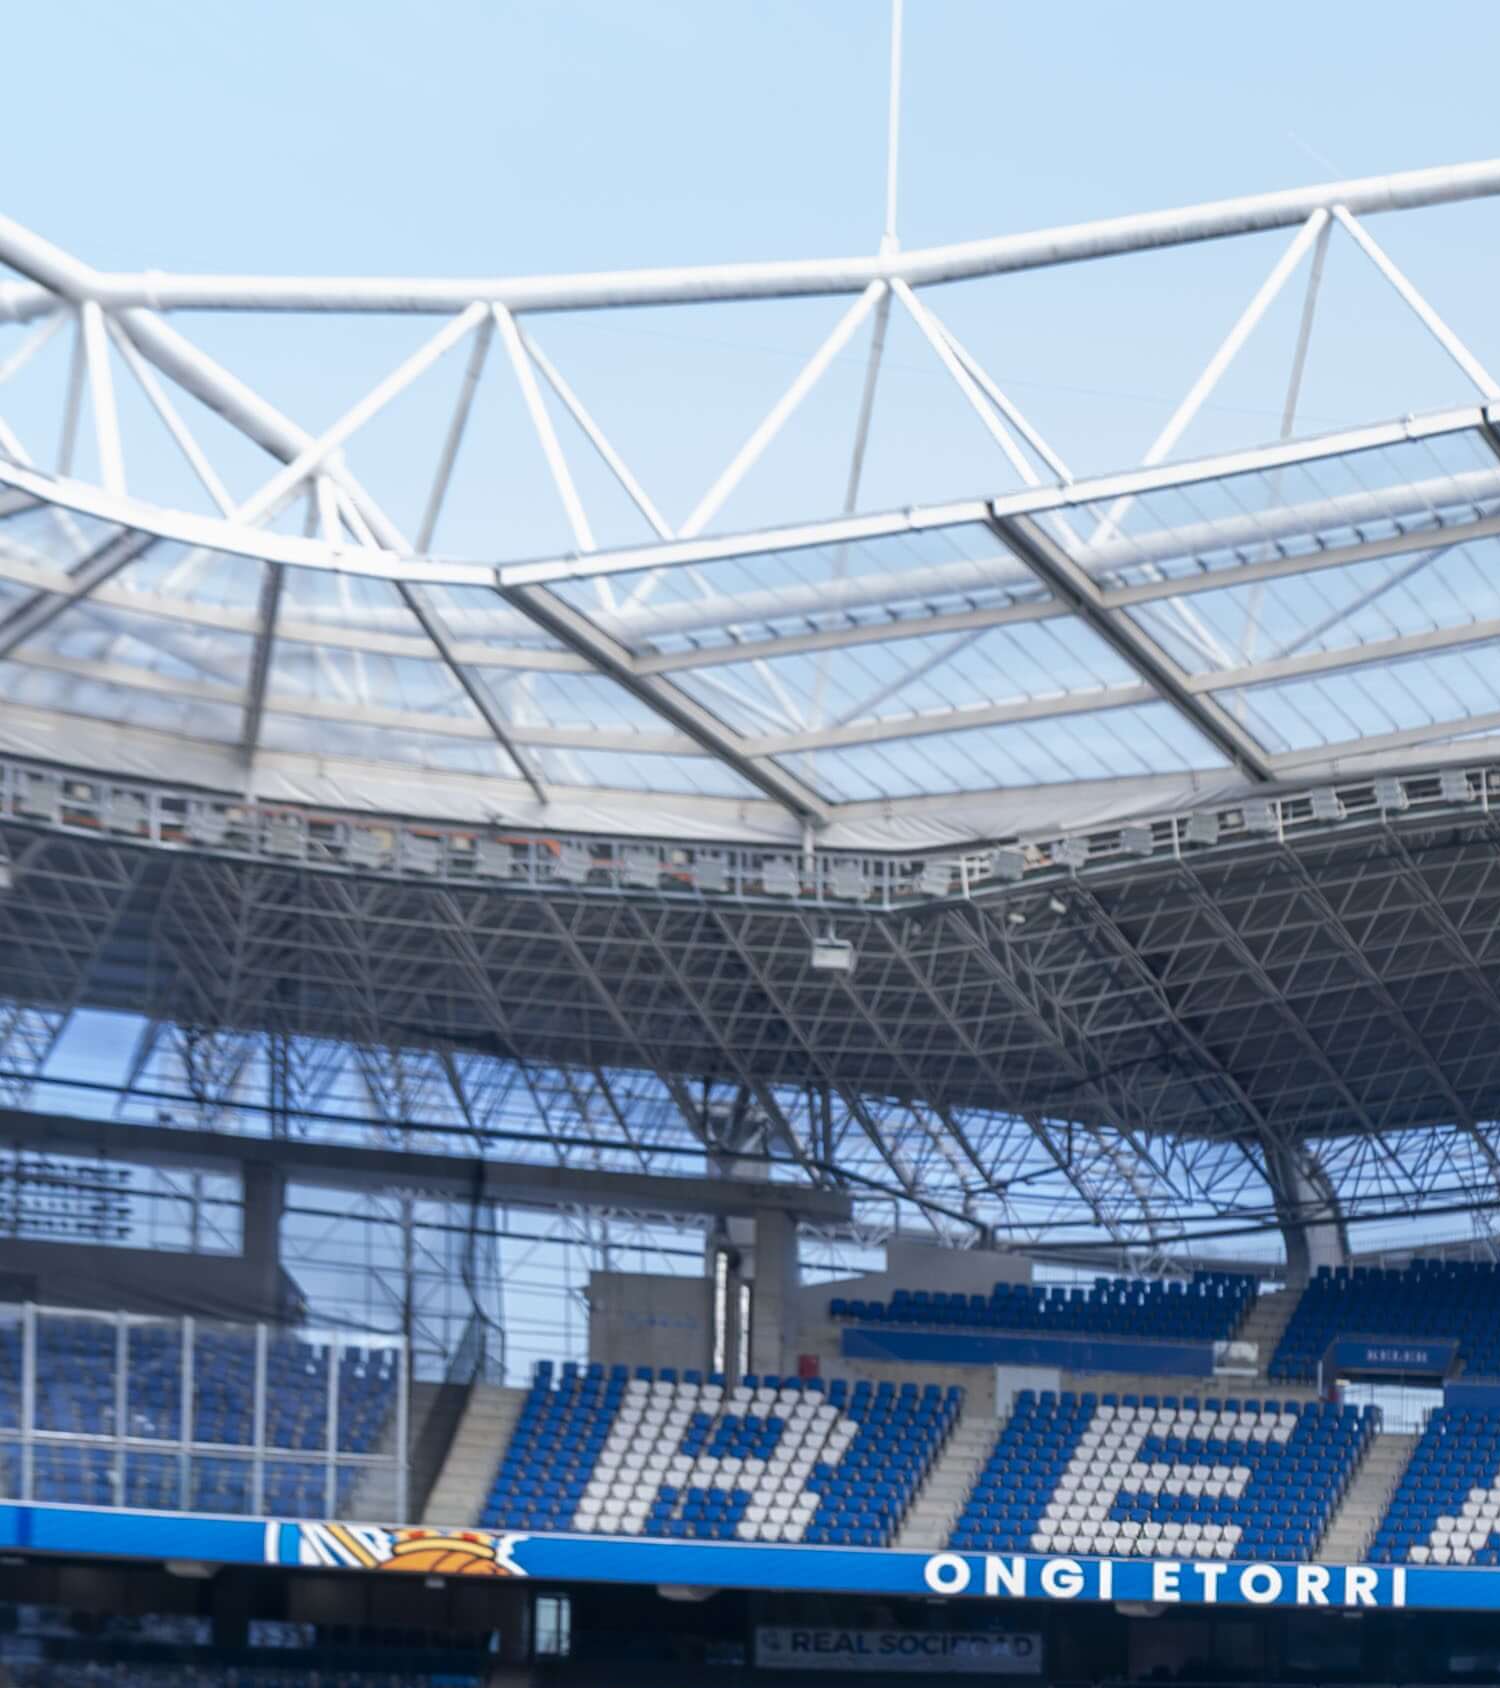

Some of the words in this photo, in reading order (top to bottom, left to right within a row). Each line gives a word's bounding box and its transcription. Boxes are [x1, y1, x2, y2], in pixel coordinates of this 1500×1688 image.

[924, 1553, 1112, 1601] ONGI
[1153, 1563, 1406, 1607] ETORRI
[791, 1631, 873, 1654] REAL
